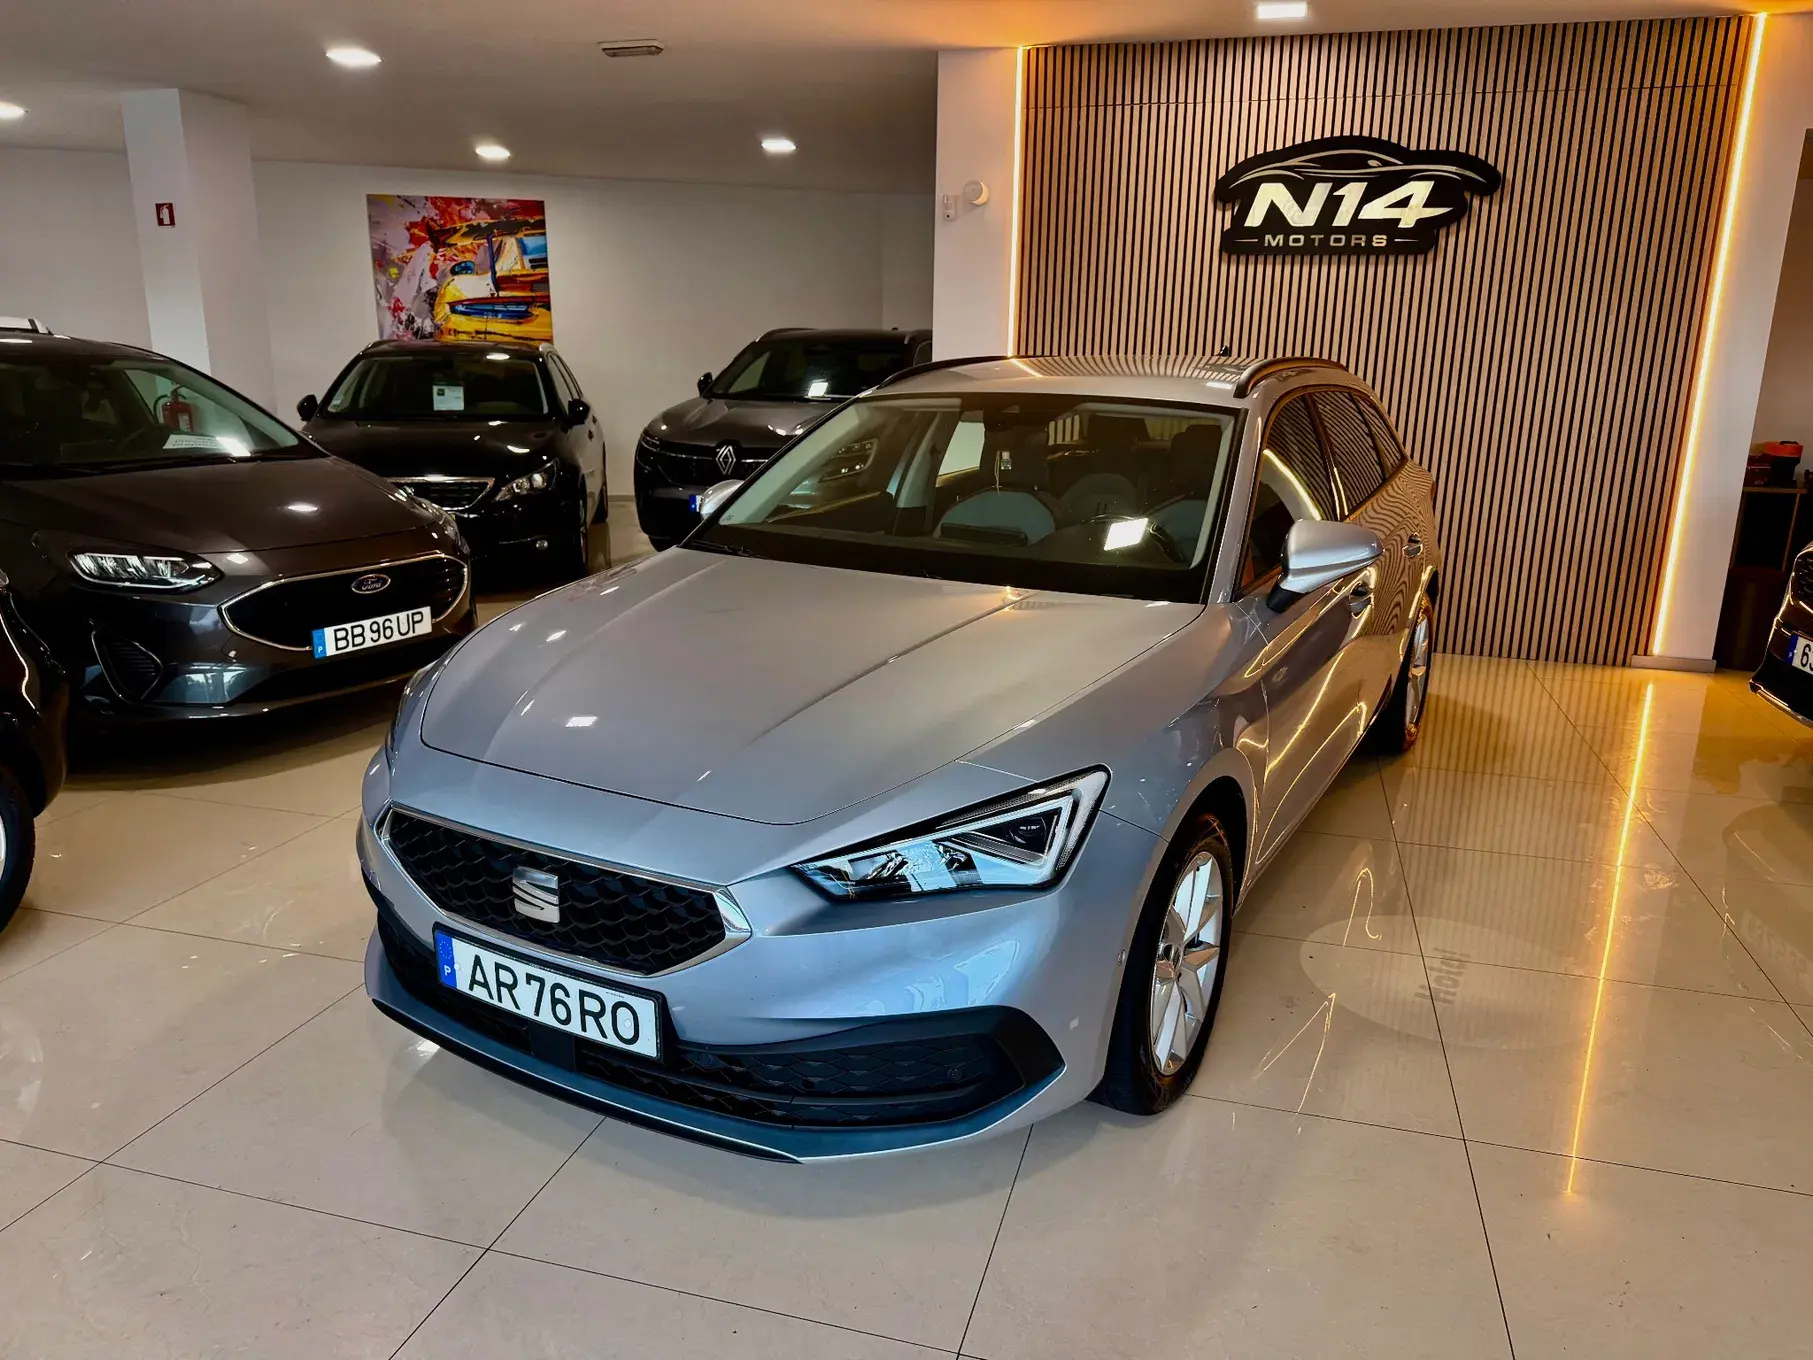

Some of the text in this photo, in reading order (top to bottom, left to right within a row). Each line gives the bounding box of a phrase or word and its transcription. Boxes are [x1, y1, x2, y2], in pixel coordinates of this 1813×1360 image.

[1243, 181, 1454, 228] N14
[1264, 234, 1388, 247] MOTORS
[443, 964, 452, 976] P
